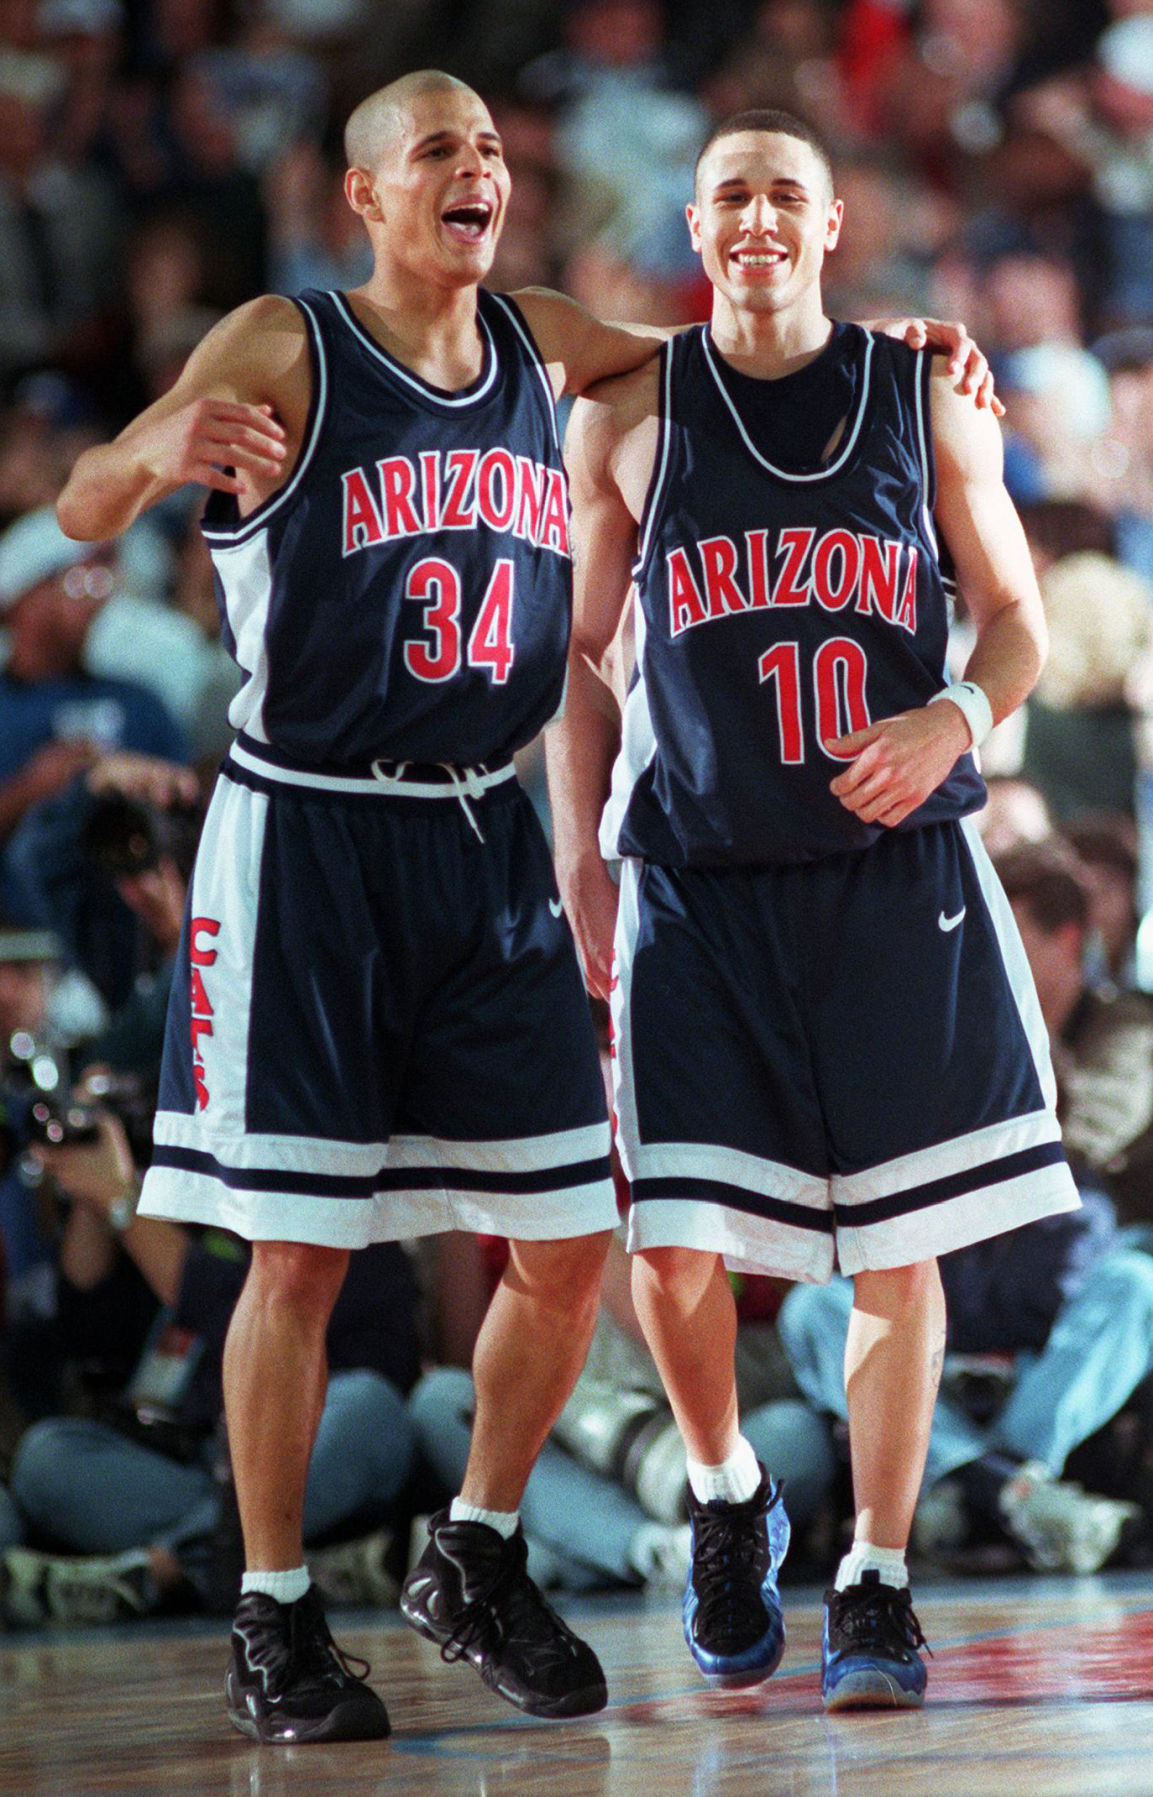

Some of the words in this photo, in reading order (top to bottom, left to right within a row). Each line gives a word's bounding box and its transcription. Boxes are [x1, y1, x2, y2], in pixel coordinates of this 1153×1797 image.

[340, 447, 571, 559] ARIZONA
[403, 557, 515, 685] 34
[666, 527, 917, 638] ARIZONA
[758, 636, 872, 764] 10
